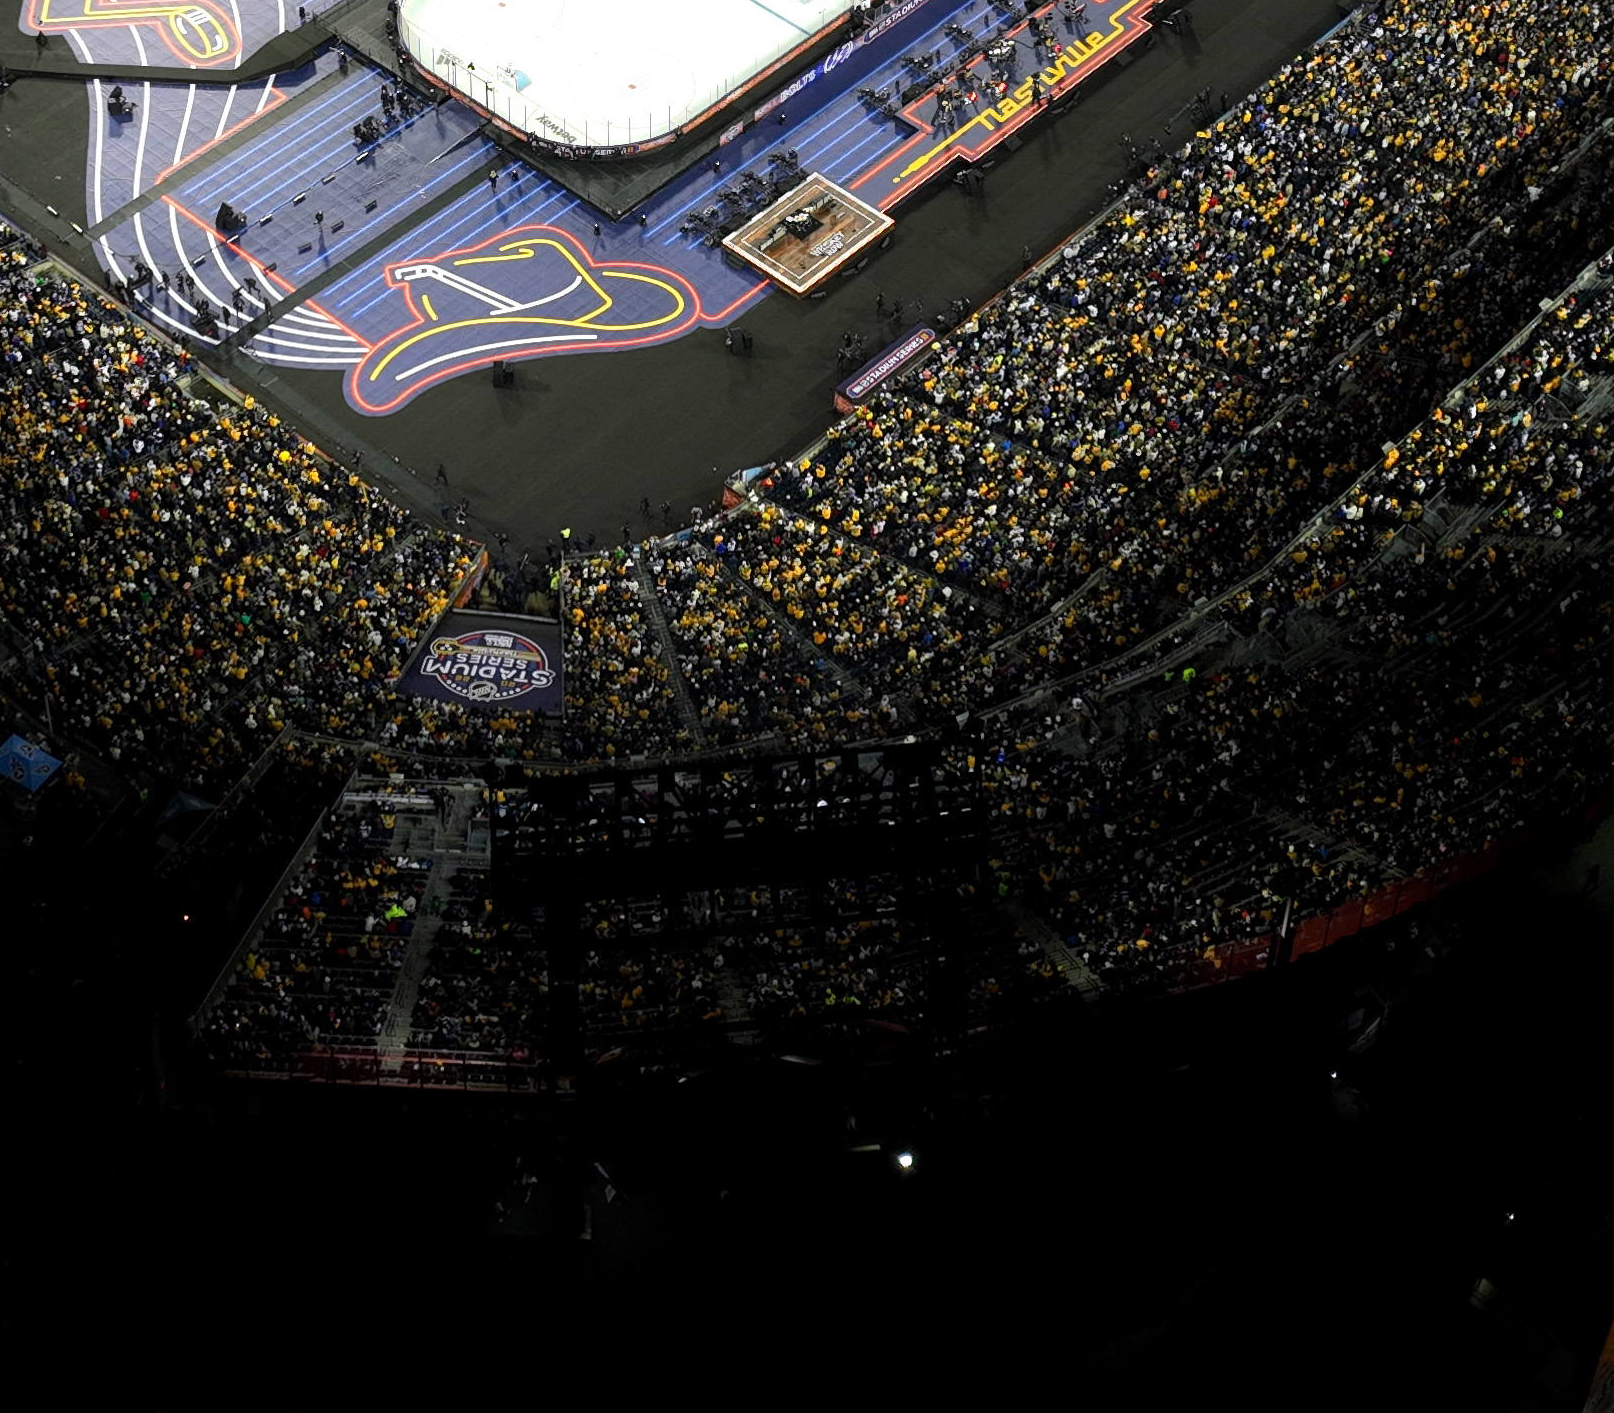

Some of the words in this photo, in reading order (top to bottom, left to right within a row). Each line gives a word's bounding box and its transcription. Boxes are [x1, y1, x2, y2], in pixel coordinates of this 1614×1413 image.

[536, 115, 578, 144] betway
[867, 356, 899, 384] STADIUM
[897, 337, 924, 359] SERIES
[425, 657, 552, 685] STADIUM
[456, 653, 529, 669] SERIES
